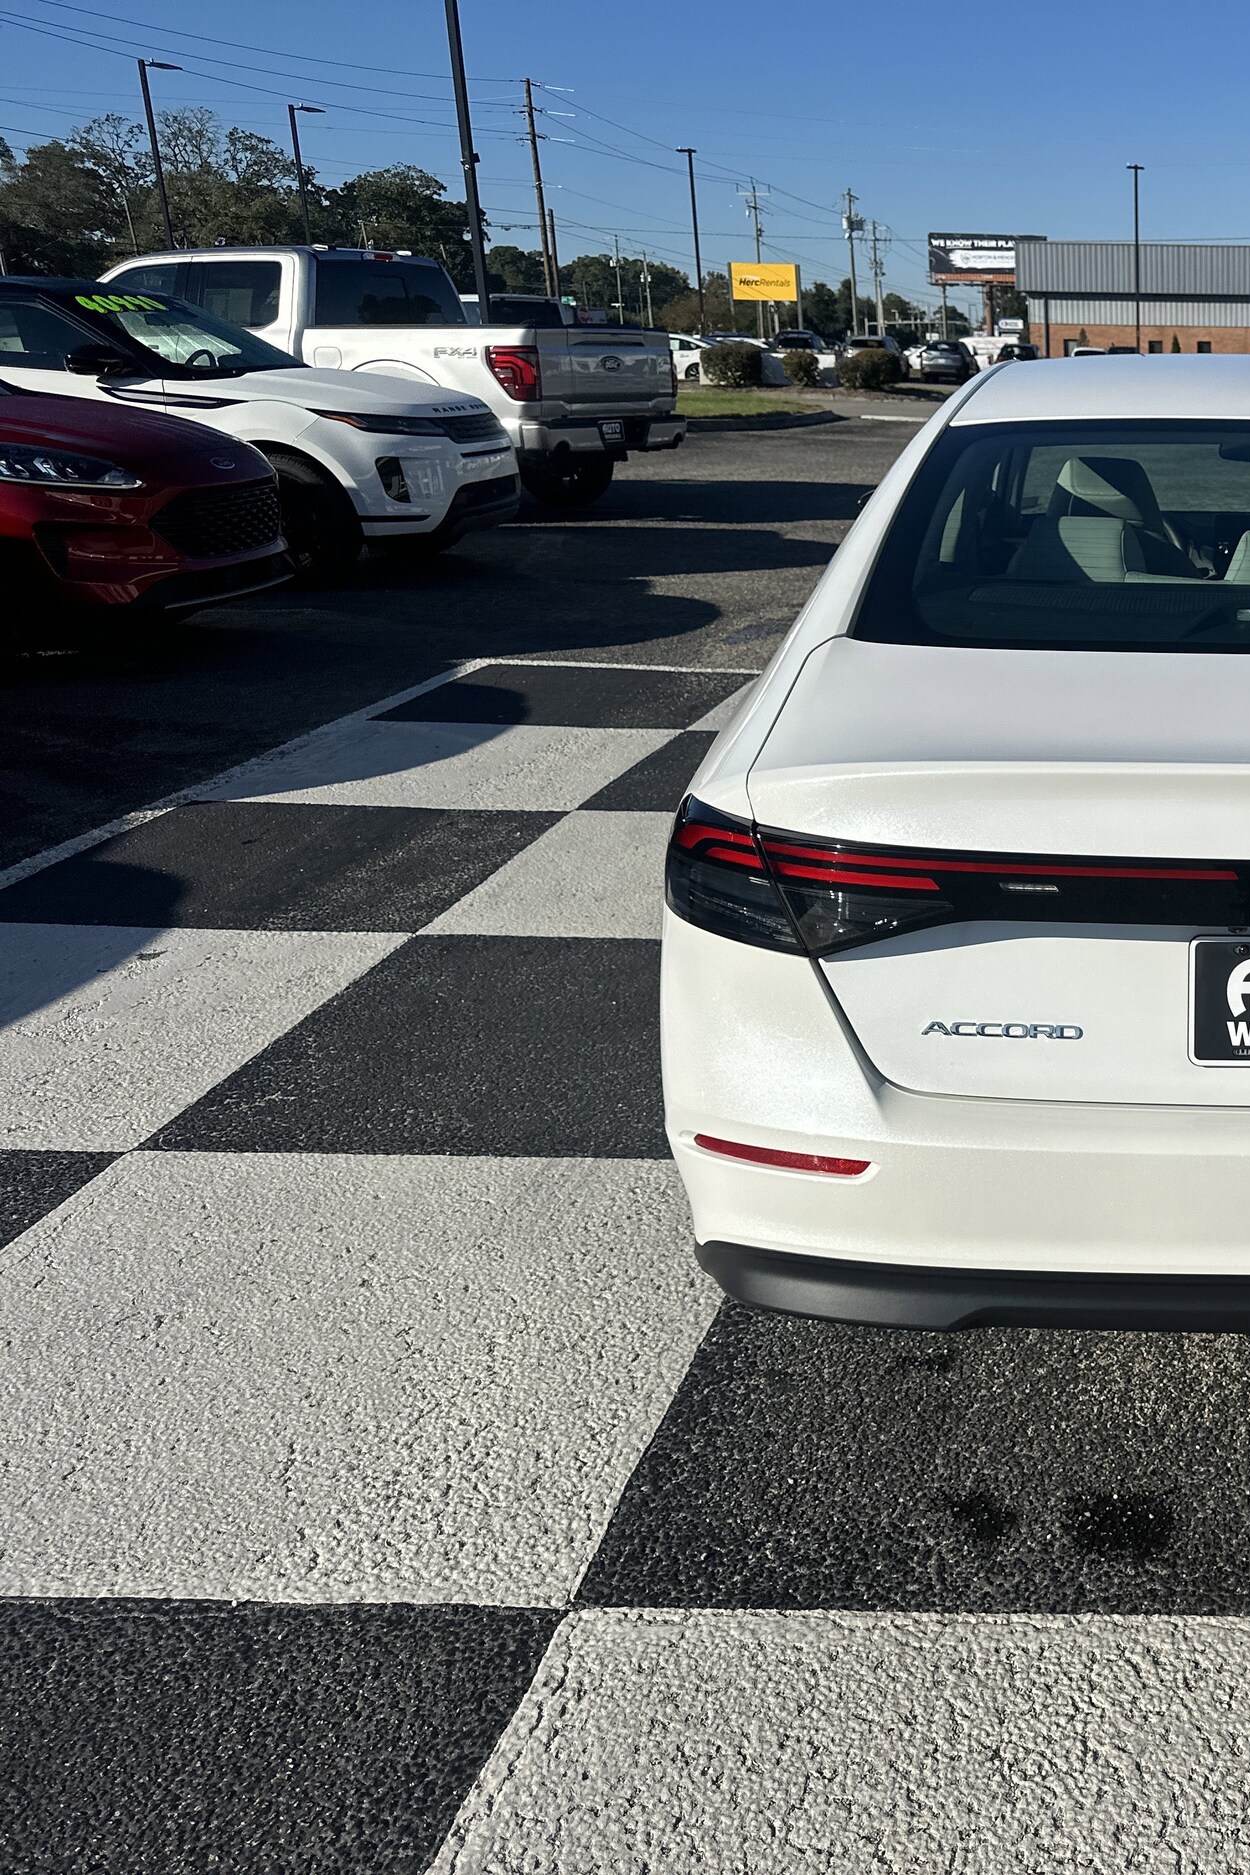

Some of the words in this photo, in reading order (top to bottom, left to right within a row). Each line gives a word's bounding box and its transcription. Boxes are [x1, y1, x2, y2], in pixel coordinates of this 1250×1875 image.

[931, 239, 945, 247] WE
[946, 239, 972, 247] KNOW
[739, 278, 791, 287] HercRentals
[75, 295, 169, 313] 40990
[433, 347, 477, 358] FX4
[921, 1021, 1084, 1040] ACCORD
